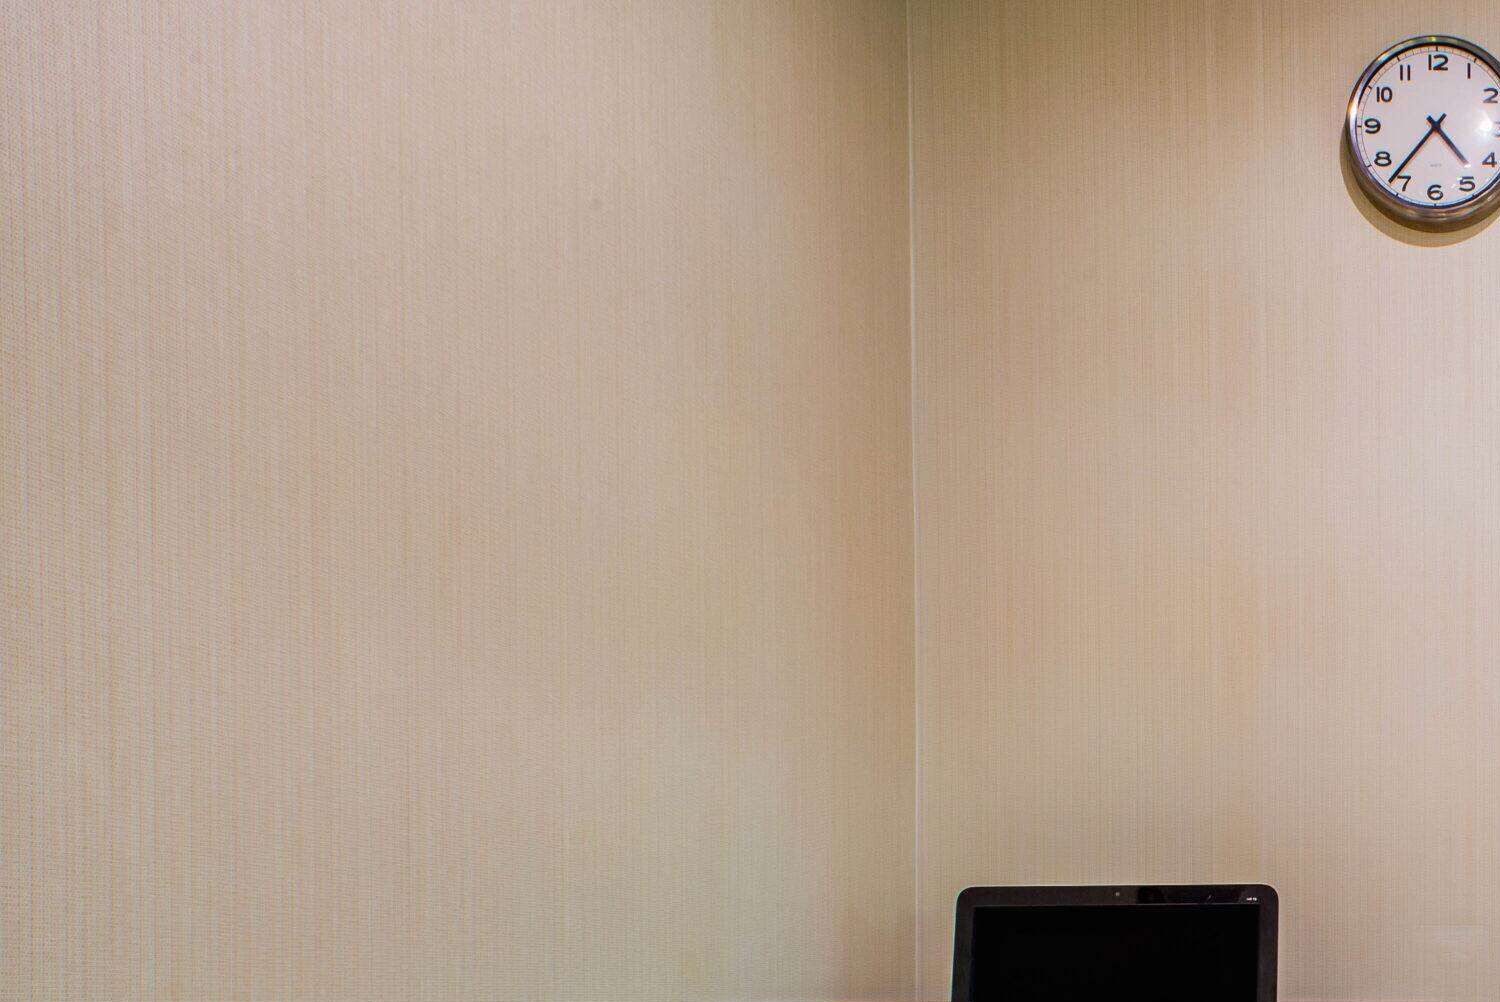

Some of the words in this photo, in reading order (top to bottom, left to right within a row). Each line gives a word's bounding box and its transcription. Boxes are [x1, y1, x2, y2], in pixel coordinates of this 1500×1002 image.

[1428, 54, 1449, 71] 12
[1466, 62, 1471, 79] 1
[1400, 64, 1411, 81] 11
[1376, 86, 1393, 103] 10
[1483, 87, 1499, 103] 2
[1364, 118, 1381, 134] 9
[1374, 151, 1392, 167] 8
[1482, 152, 1498, 168] 4
[1397, 175, 1412, 191] 7
[1459, 175, 1476, 191] 5
[1427, 184, 1444, 200] 6
